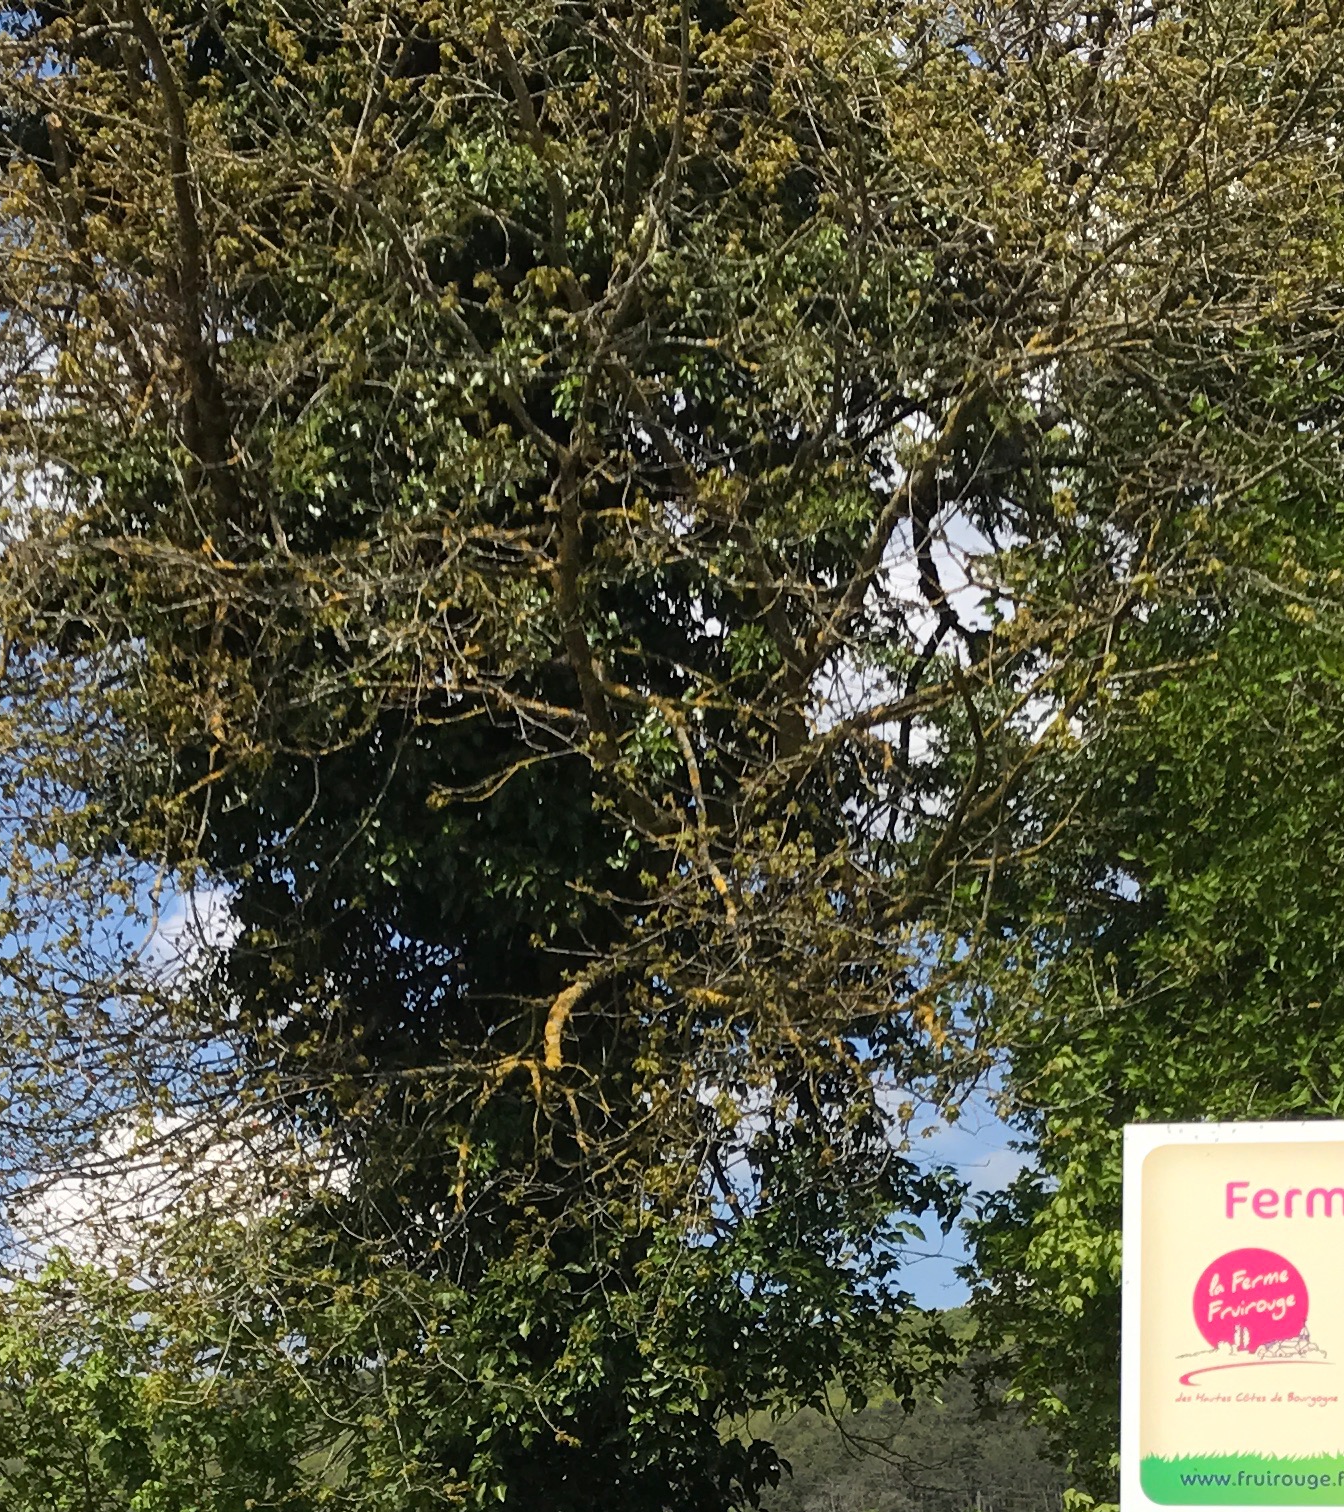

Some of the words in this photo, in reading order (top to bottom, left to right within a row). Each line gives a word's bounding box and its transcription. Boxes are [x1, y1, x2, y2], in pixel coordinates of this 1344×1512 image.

[1208, 1273, 1225, 1297] la
[1231, 1269, 1289, 1293] Ferme
[1208, 1294, 1296, 1322] Fruirouge
[1175, 1391, 1192, 1403] des
[1196, 1392, 1232, 1403] Hautes
[1235, 1391, 1267, 1403] Côtes
[1269, 1391, 1283, 1403] de
[1287, 1391, 1339, 1407] Bourgogne
